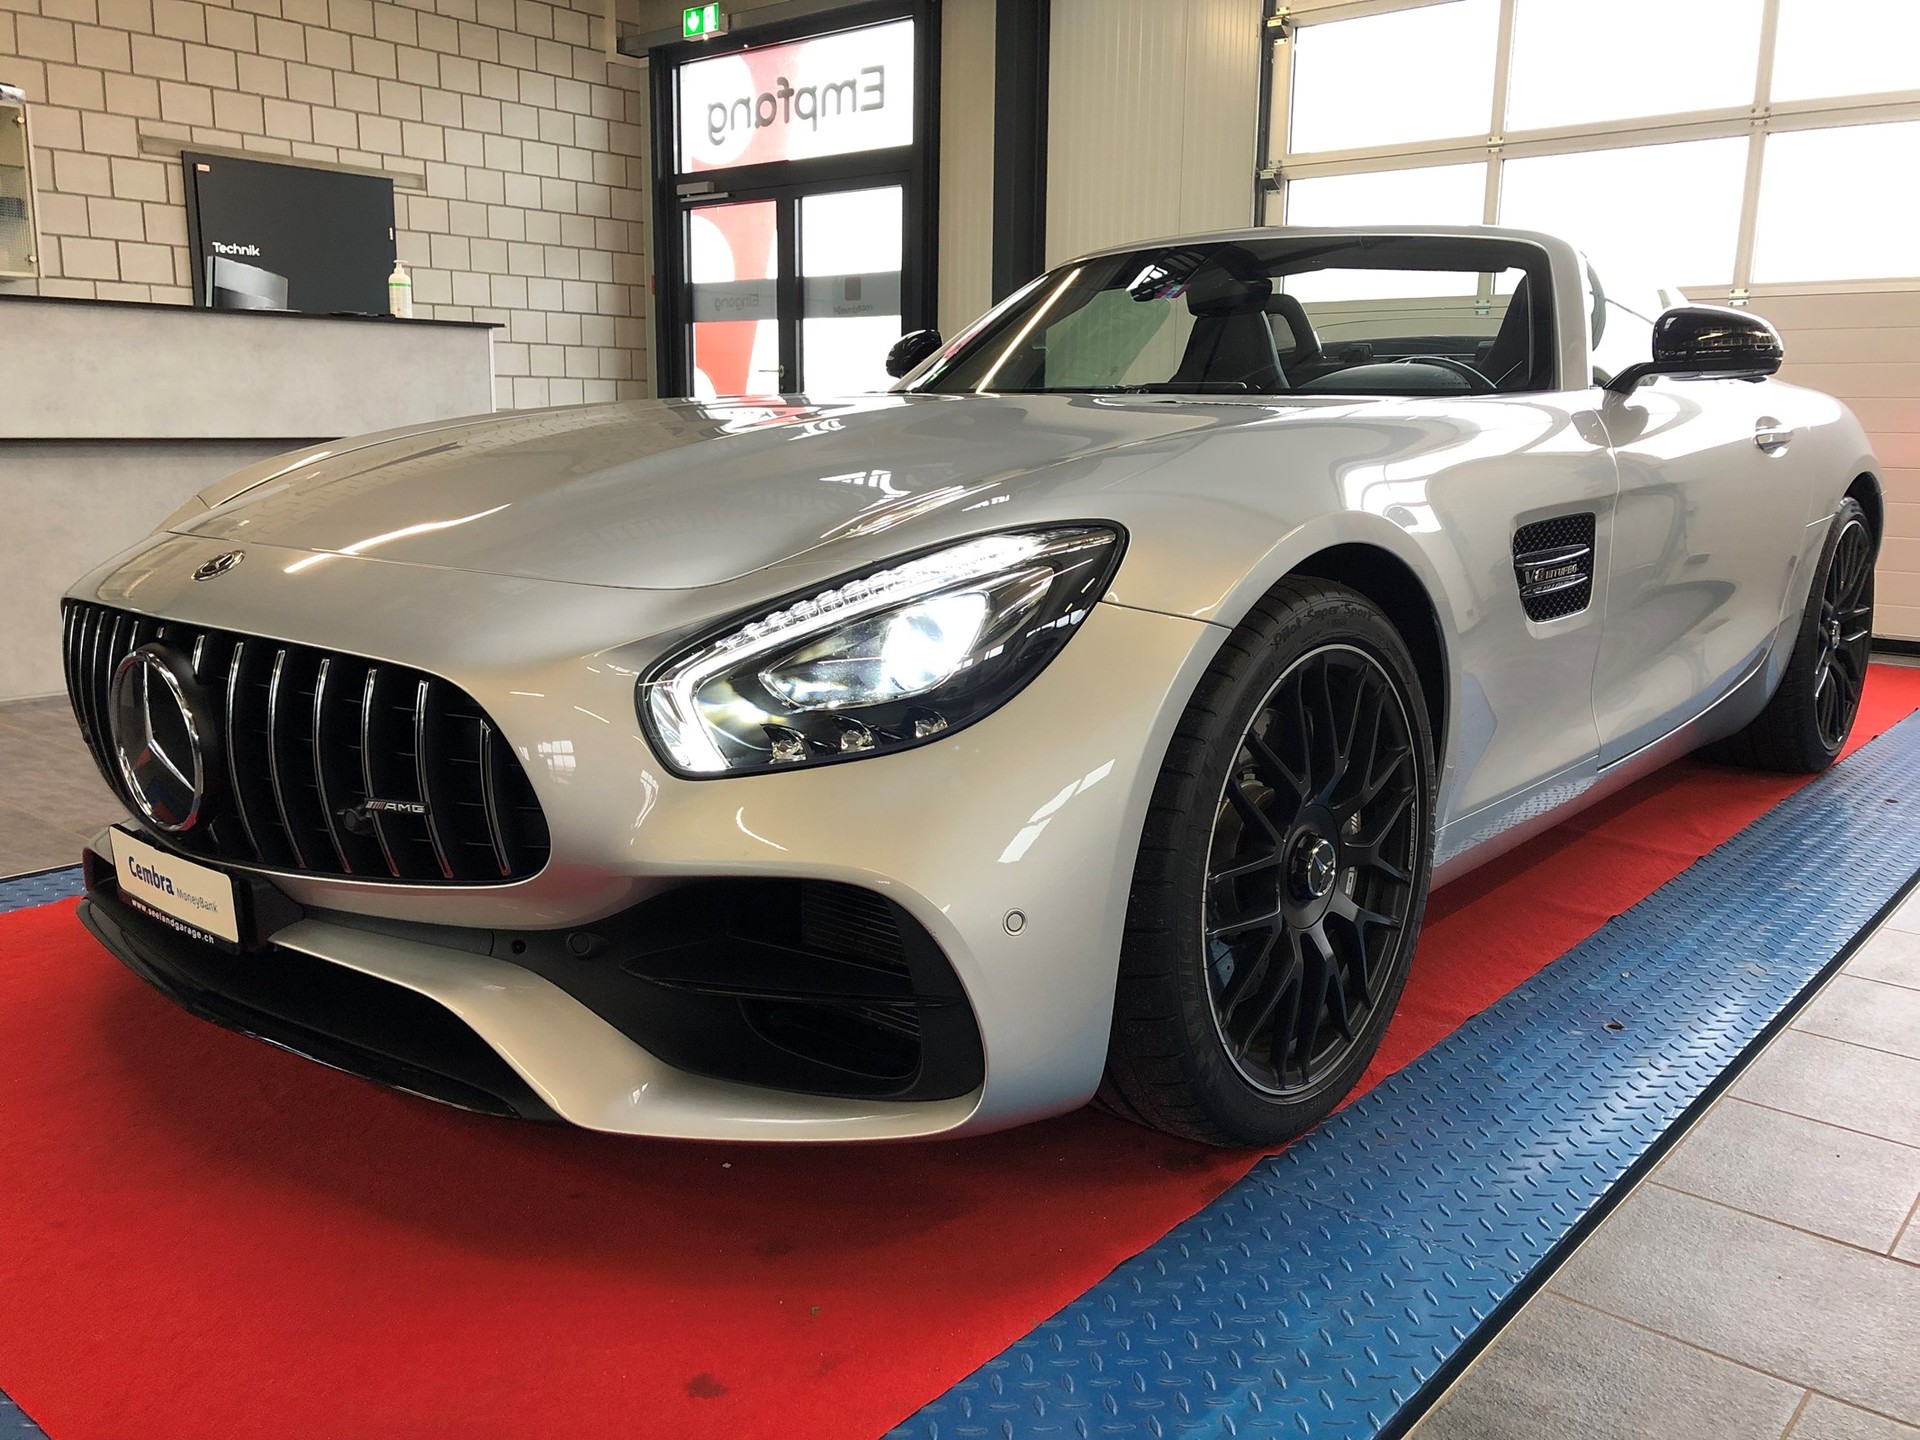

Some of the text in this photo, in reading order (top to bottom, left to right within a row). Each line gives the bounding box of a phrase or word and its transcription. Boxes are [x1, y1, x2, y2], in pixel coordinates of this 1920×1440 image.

[212, 241, 260, 257] Technik
[1525, 568, 1546, 584] V8
[383, 802, 425, 813] AMG
[128, 855, 219, 913] Cembra MoneyBank
[131, 899, 215, 945] www.seelandgarage.ch
